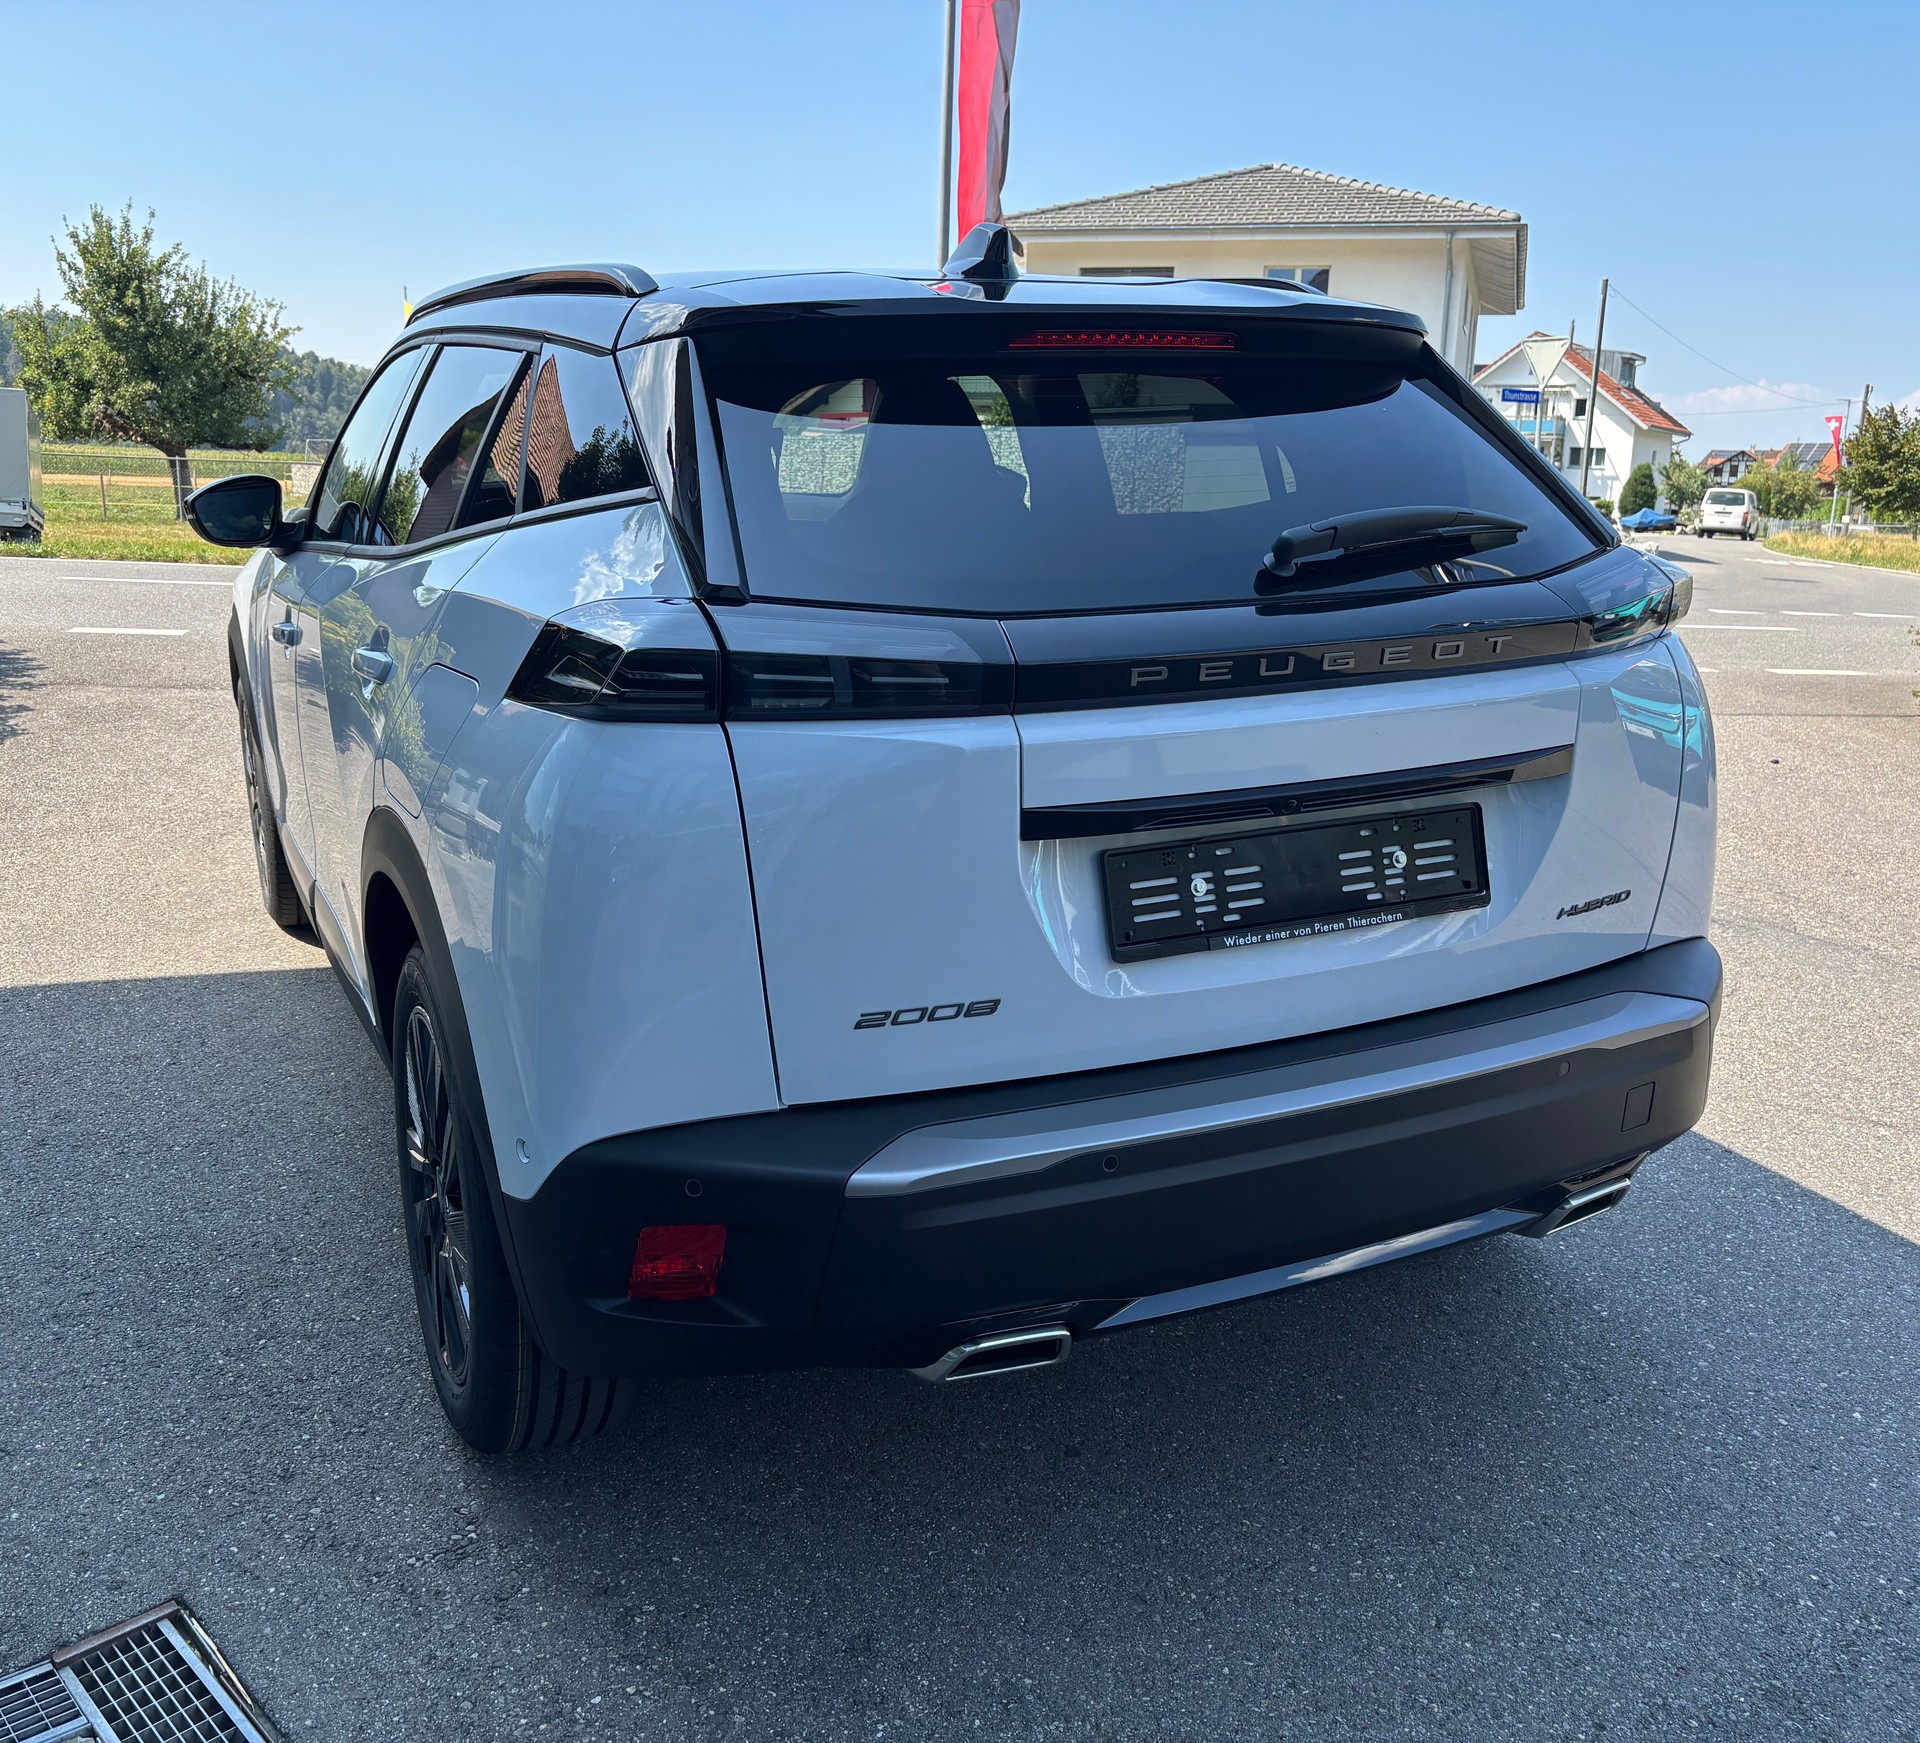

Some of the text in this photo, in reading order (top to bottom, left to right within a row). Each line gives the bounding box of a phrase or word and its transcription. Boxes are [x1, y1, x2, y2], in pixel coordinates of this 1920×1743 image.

[1504, 390, 1537, 401] Thunstrasse
[1130, 634, 1513, 687] PEUGEOT
[1556, 889, 1631, 920] HYBRID
[1224, 912, 1403, 947] Wieder einer von Pieren Thierachern
[853, 998, 1002, 1030] 2008
